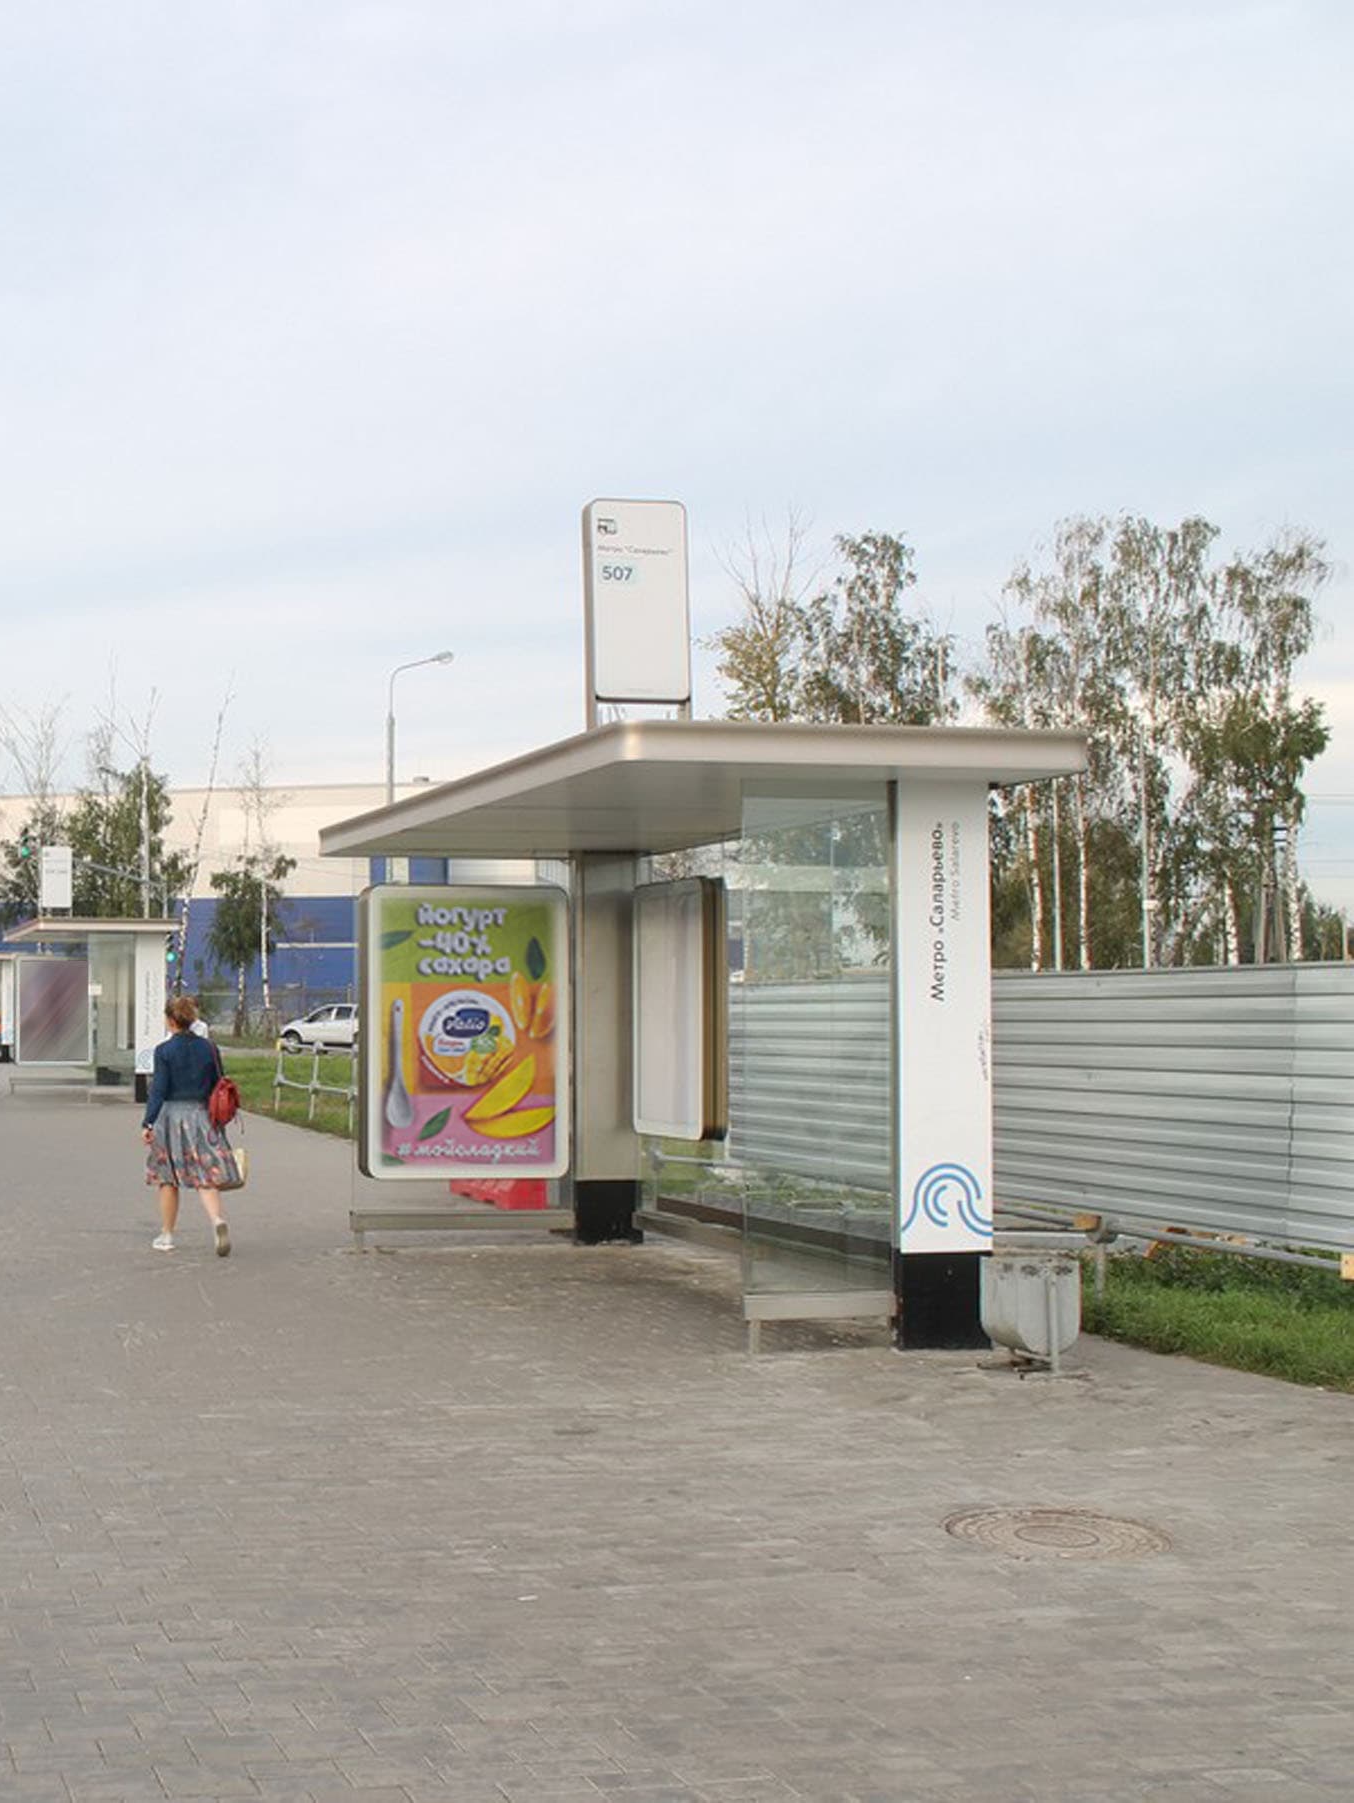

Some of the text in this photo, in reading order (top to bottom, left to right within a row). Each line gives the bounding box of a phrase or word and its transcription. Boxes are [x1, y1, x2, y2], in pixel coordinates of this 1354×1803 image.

[602, 566, 633, 581] 507
[418, 931, 491, 955] -40%
[418, 957, 511, 982] сахара
[930, 940, 946, 1001] Метро
